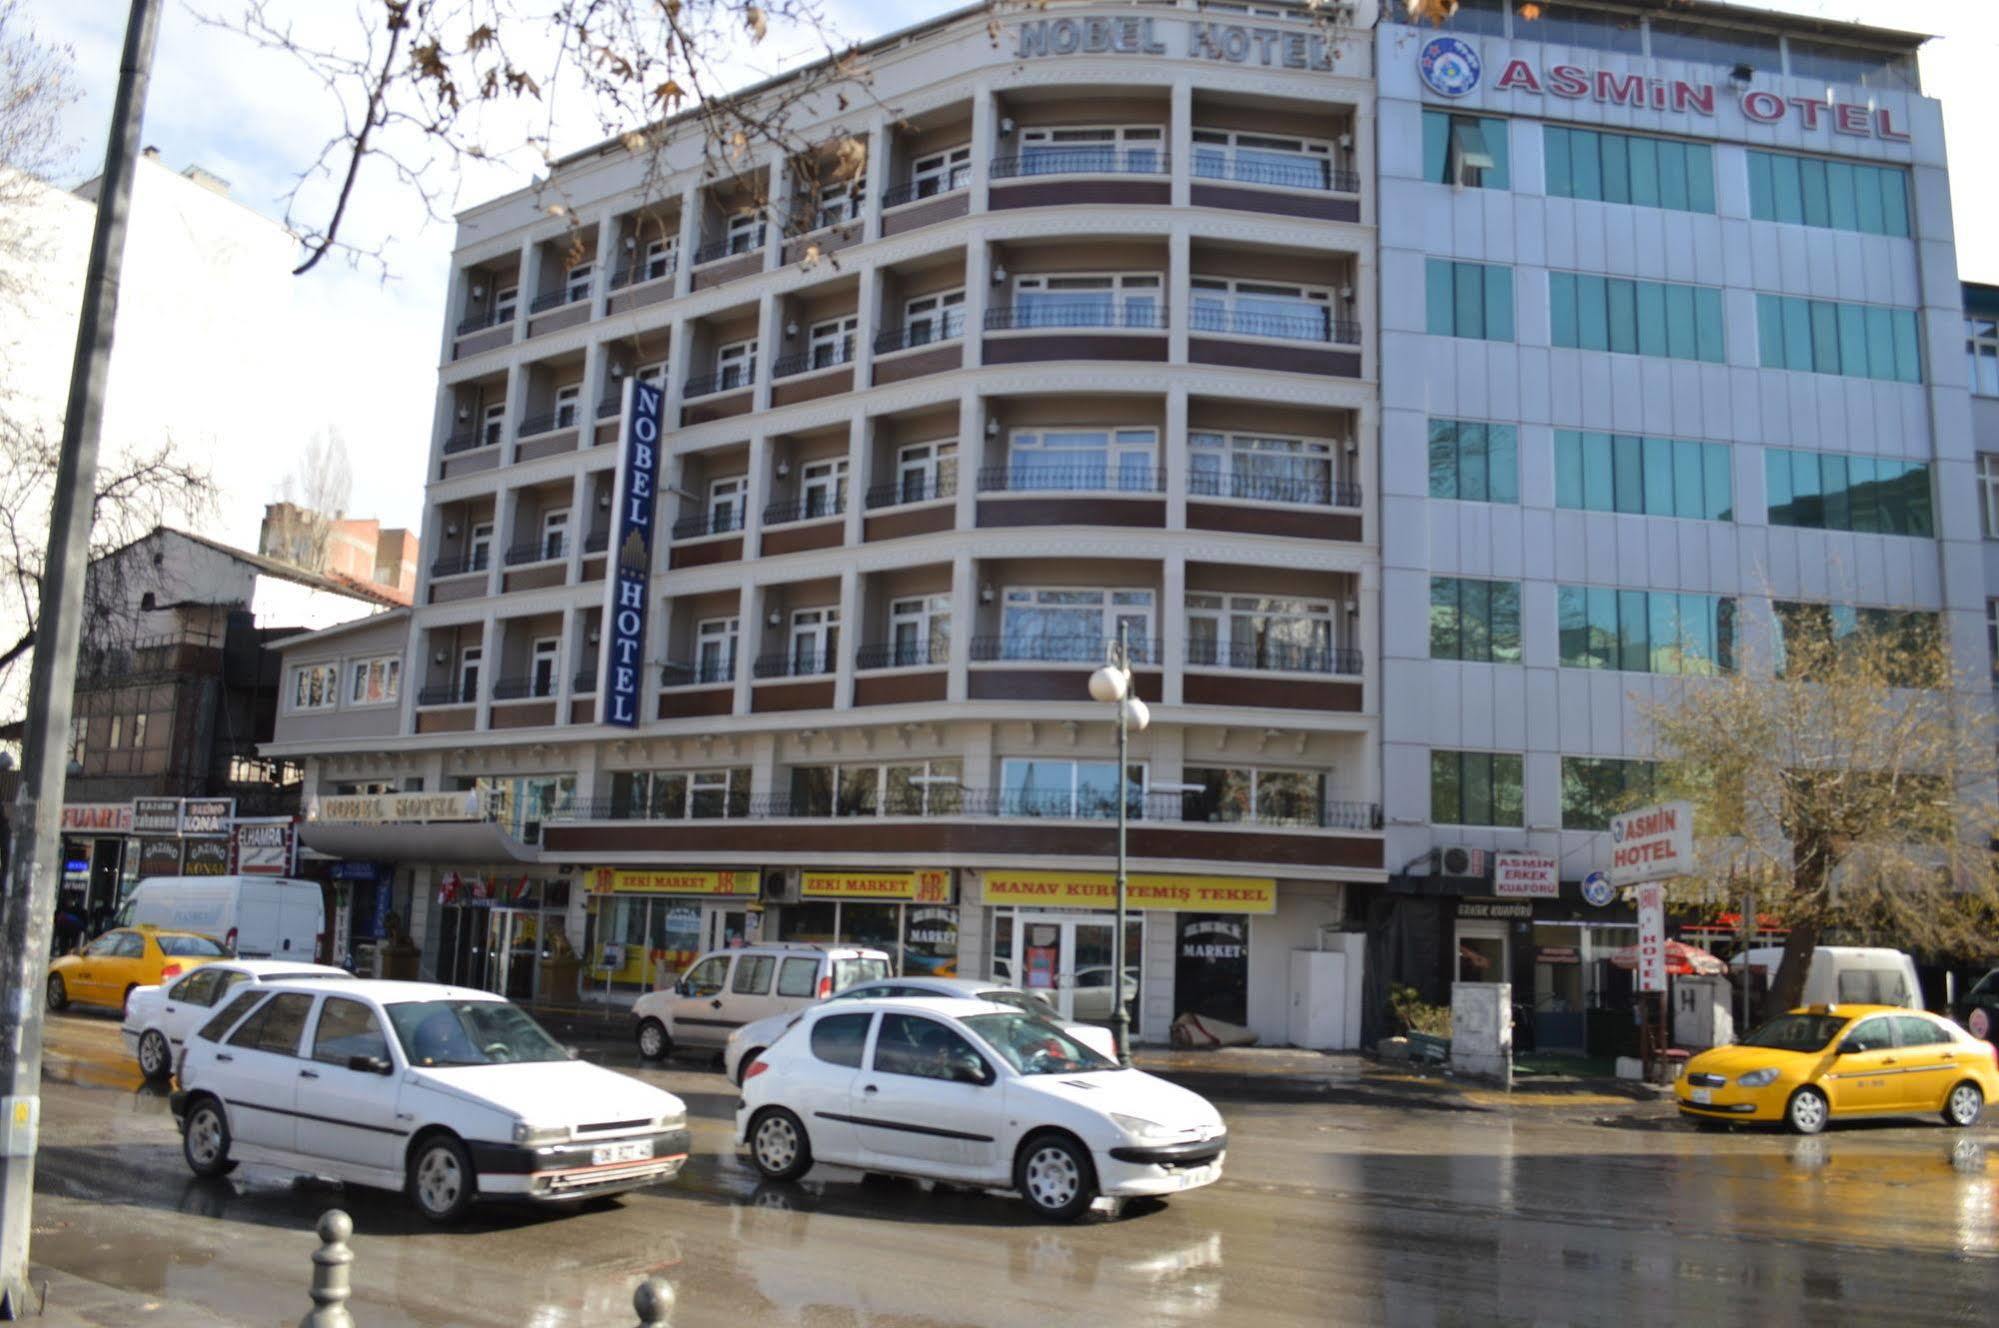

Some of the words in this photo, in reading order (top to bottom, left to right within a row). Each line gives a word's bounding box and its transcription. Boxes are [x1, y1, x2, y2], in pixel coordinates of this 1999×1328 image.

[1020, 16, 1167, 59] NOBEL
[1189, 21, 1335, 72] HOTEL
[1740, 90, 1913, 143] OTEL
[629, 387, 659, 526] NOBEL
[613, 580, 643, 723] HOTEL
[1613, 839, 1678, 868] HOTEL
[654, 876, 707, 888] MARKET
[846, 879, 909, 892] MARKET
[1504, 870, 1548, 880] ERKEK
[990, 880, 1060, 896] MANAV
[1197, 887, 1268, 902] TEKEL
[909, 929, 958, 943] MARKET
[1183, 944, 1242, 959] MARKET
